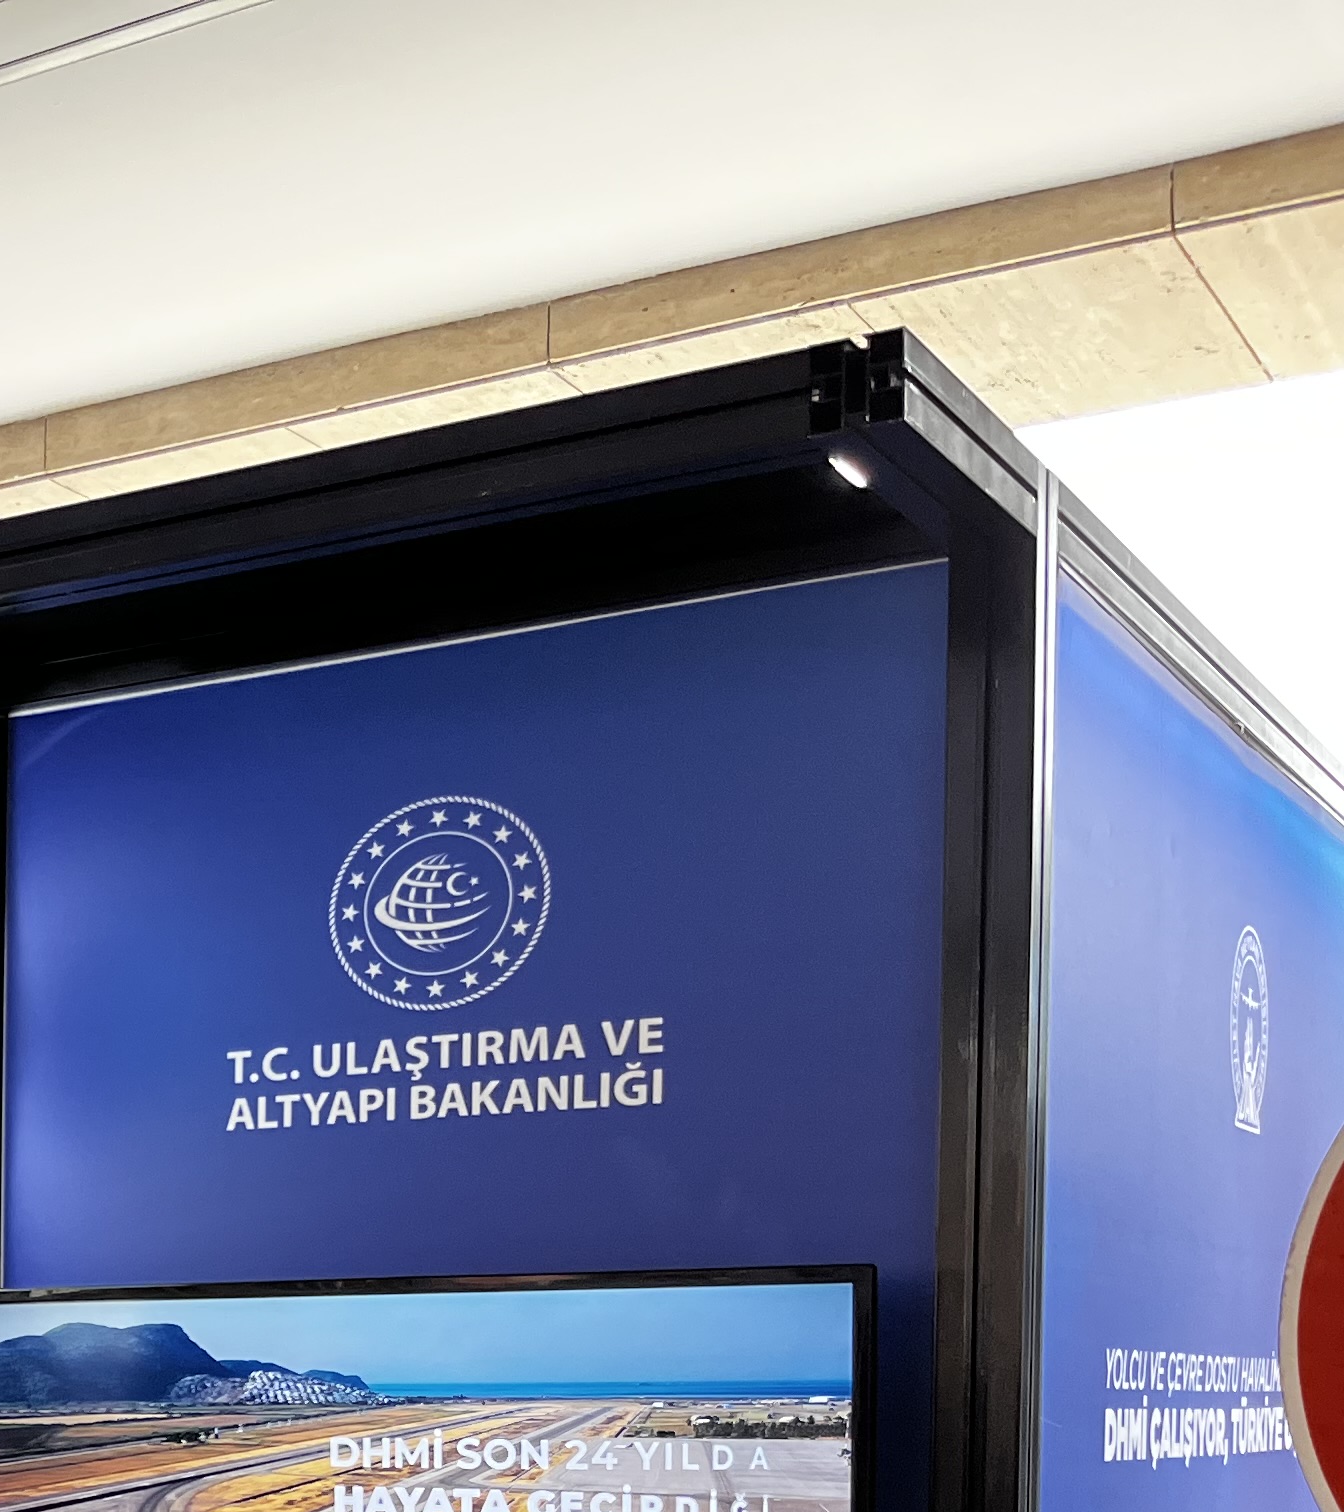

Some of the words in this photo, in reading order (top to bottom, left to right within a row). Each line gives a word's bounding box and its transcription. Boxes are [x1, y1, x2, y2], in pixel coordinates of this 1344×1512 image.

[226, 1046, 300, 1085] T.C.
[311, 1022, 586, 1081] ULAŞTIRMA
[600, 1016, 665, 1058] VE
[225, 1085, 397, 1132] ALTYAPI
[410, 1061, 664, 1121] BAKANLIĞI
[1106, 1348, 1148, 1390] YOLCU
[1150, 1351, 1166, 1391] VE
[1168, 1352, 1204, 1398] ÇEVRE
[1205, 1355, 1240, 1392] DOSTU
[329, 1428, 444, 1471] DHMİ
[455, 1437, 550, 1472] SON
[565, 1439, 618, 1471] 24
[1104, 1395, 1148, 1462] DHMİ
[1150, 1406, 1229, 1470] ÇALIŞIYOR,
[1231, 1396, 1284, 1455] TÜRKİYE
